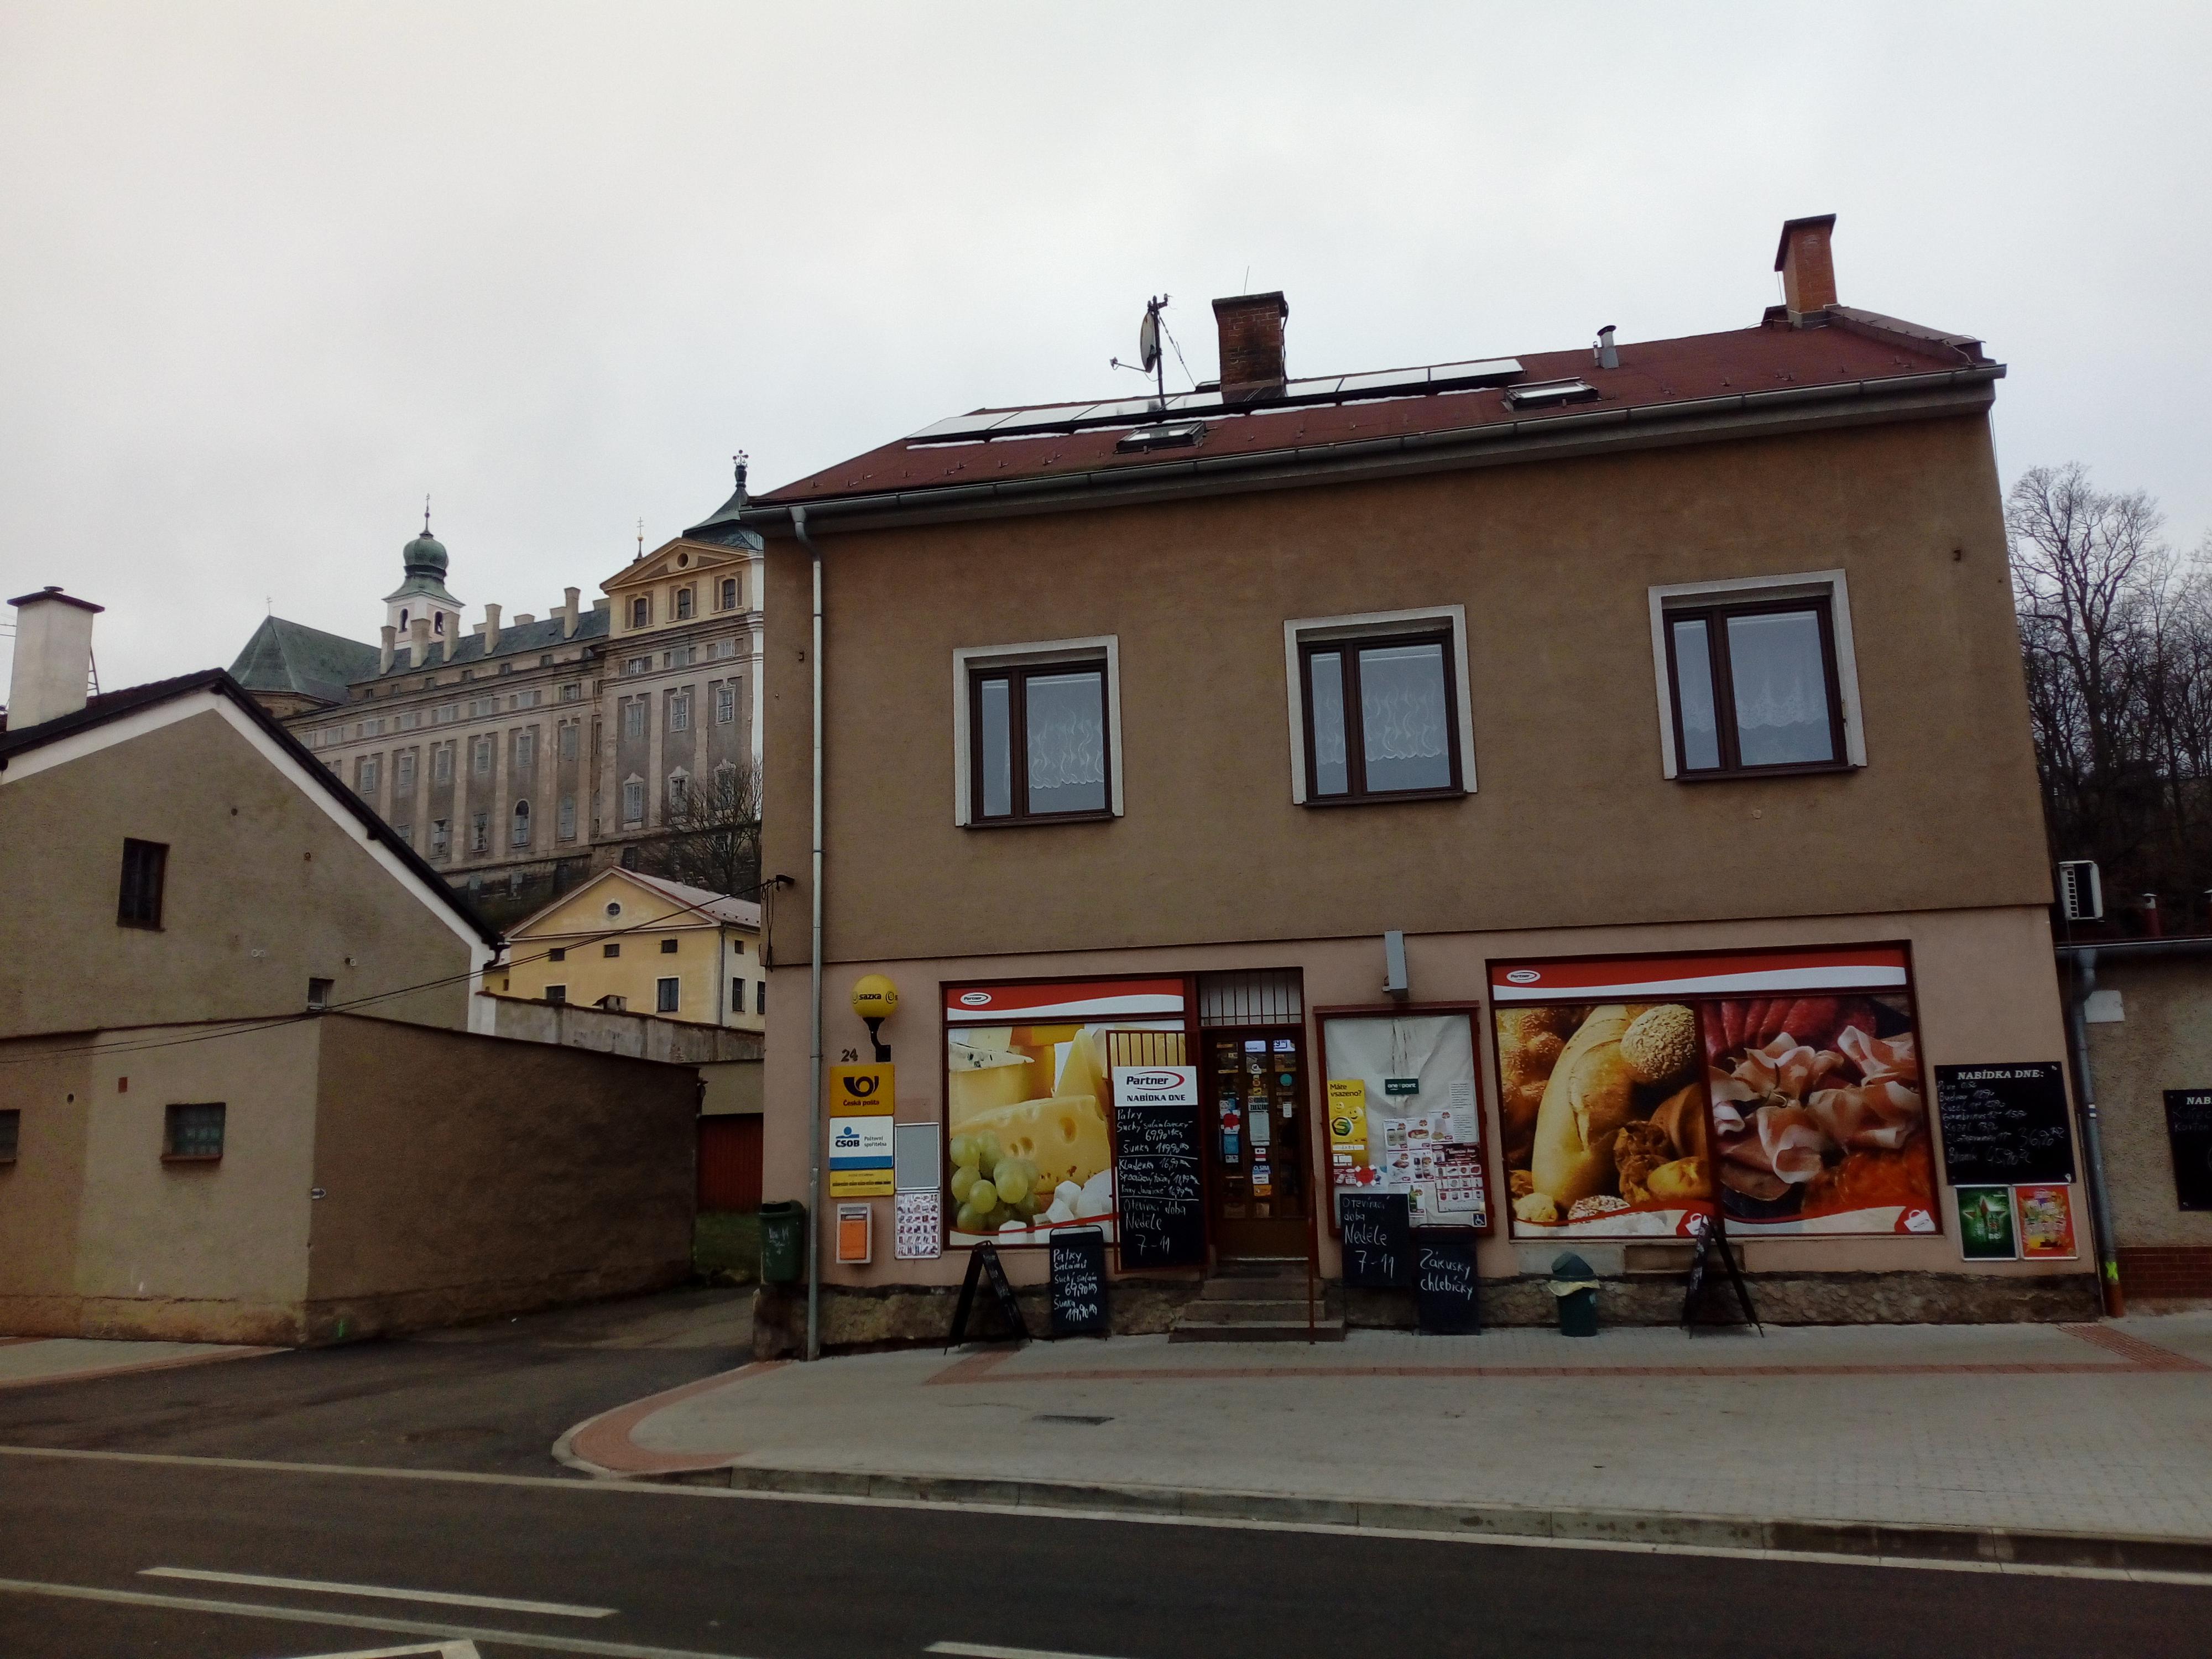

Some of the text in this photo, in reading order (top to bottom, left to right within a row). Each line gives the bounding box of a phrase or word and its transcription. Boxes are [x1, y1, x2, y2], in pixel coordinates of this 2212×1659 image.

[841, 1047, 859, 1062] 24
[1957, 1070, 2044, 1080] NABÍDKA DNE:
[1126, 1076, 1168, 1086] Partner
[1126, 1093, 1167, 1102] NABÍDKA
[2186, 1096, 2212, 1105] NAB
[843, 1098, 861, 1107] Česká
[836, 1139, 860, 1147] ČSOB
